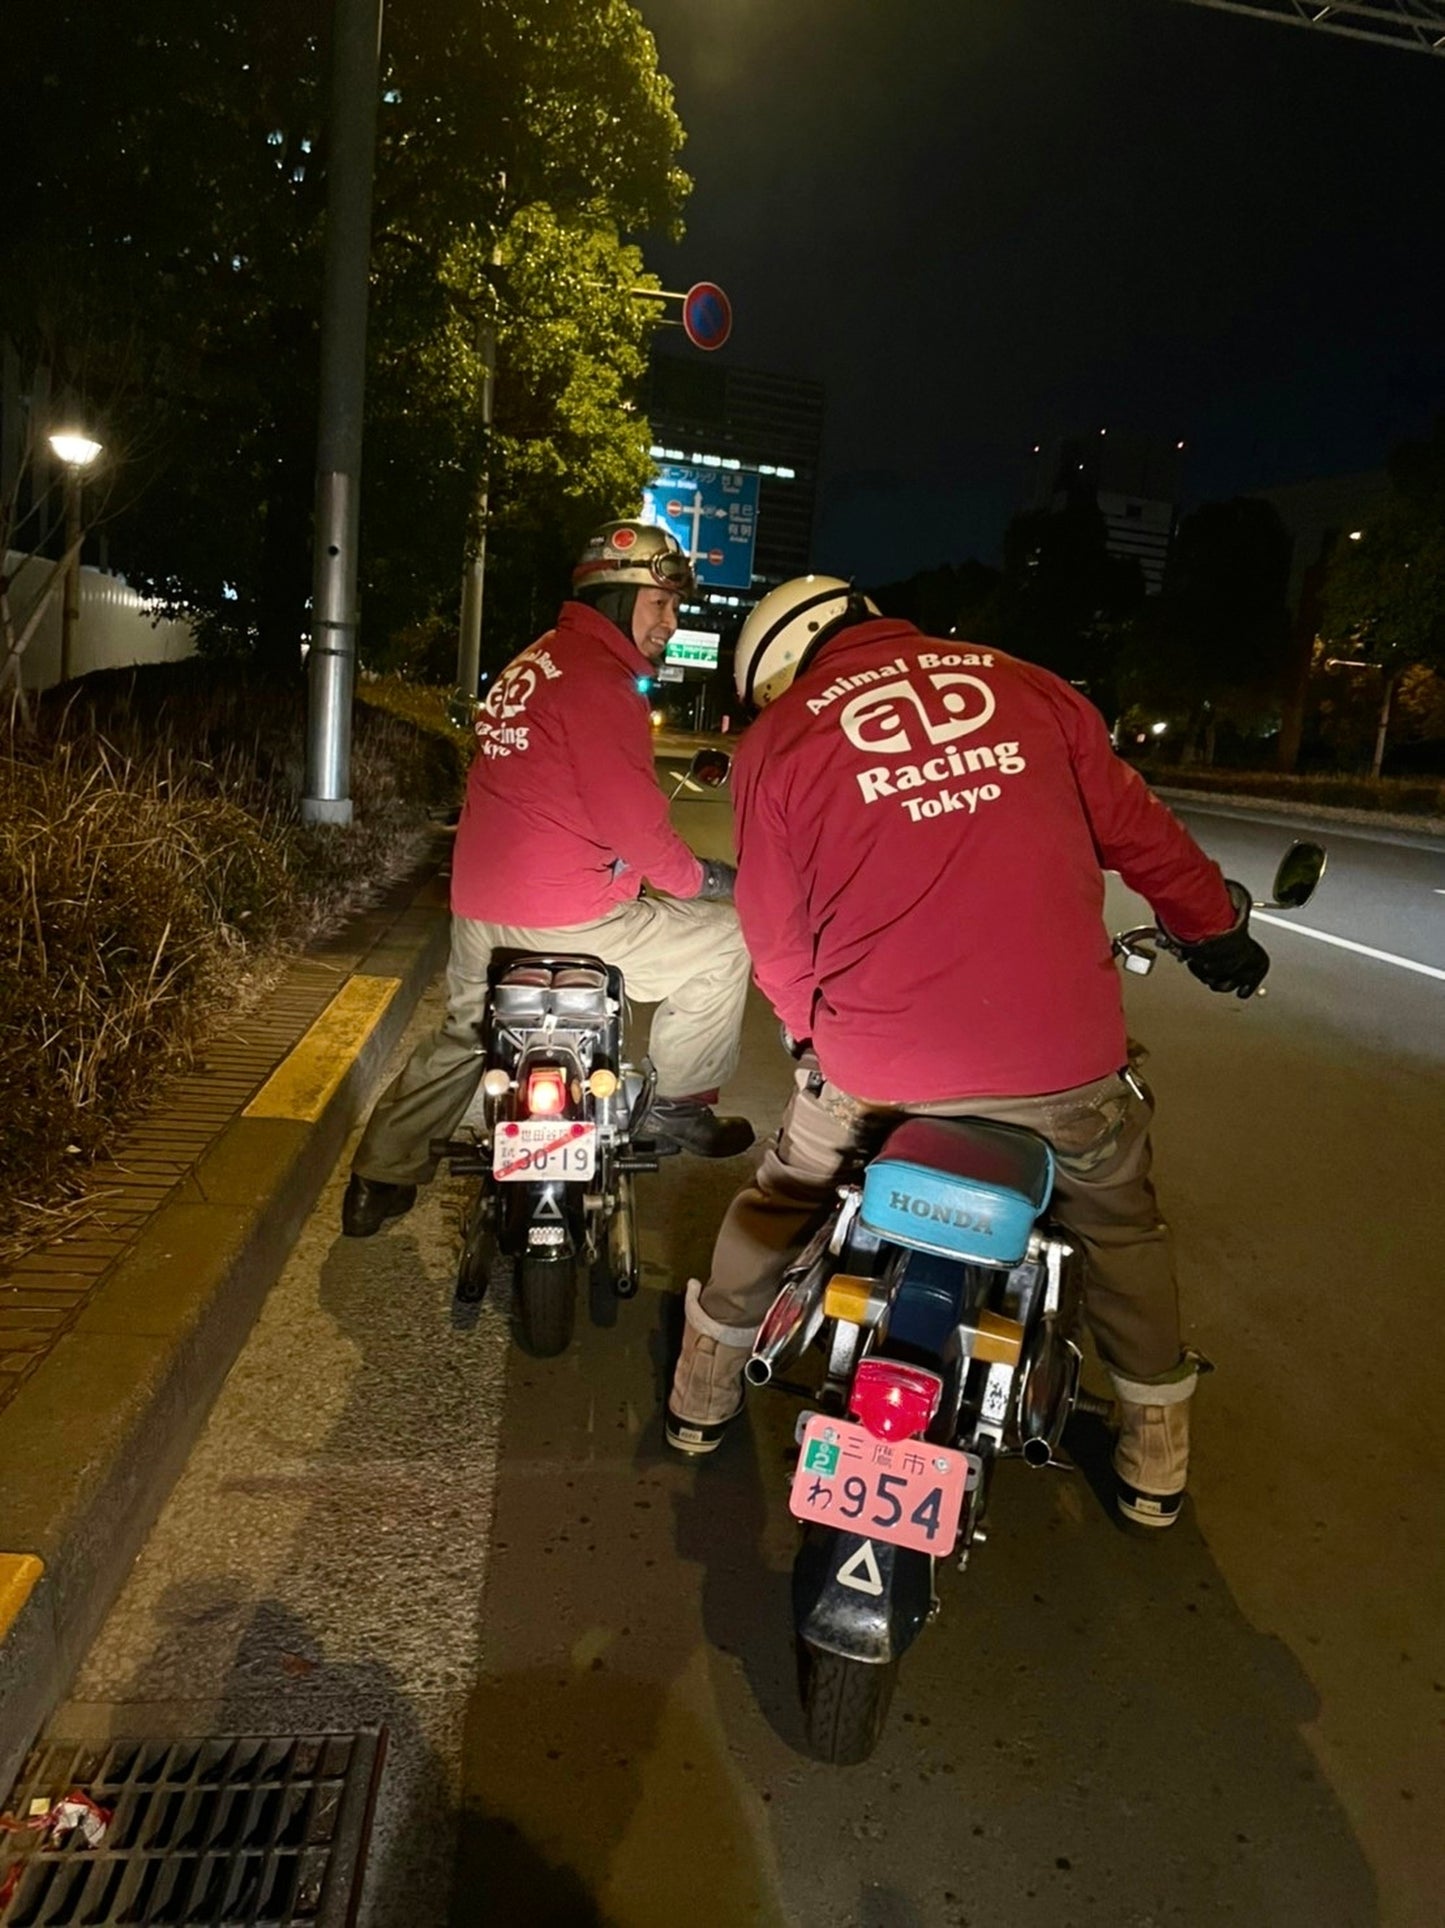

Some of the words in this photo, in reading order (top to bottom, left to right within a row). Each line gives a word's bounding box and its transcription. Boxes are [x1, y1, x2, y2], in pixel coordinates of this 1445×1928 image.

[806, 658, 910, 716] Animal
[917, 653, 995, 670] Boat
[856, 741, 1026, 804] Racing
[901, 783, 1002, 823] Tokyo
[518, 1148, 589, 1171] 30-19
[889, 1191, 994, 1236] HONDA
[842, 1436, 927, 1476] 三鷹市
[807, 1477, 833, 1510] わ
[839, 1473, 944, 1541] 954
